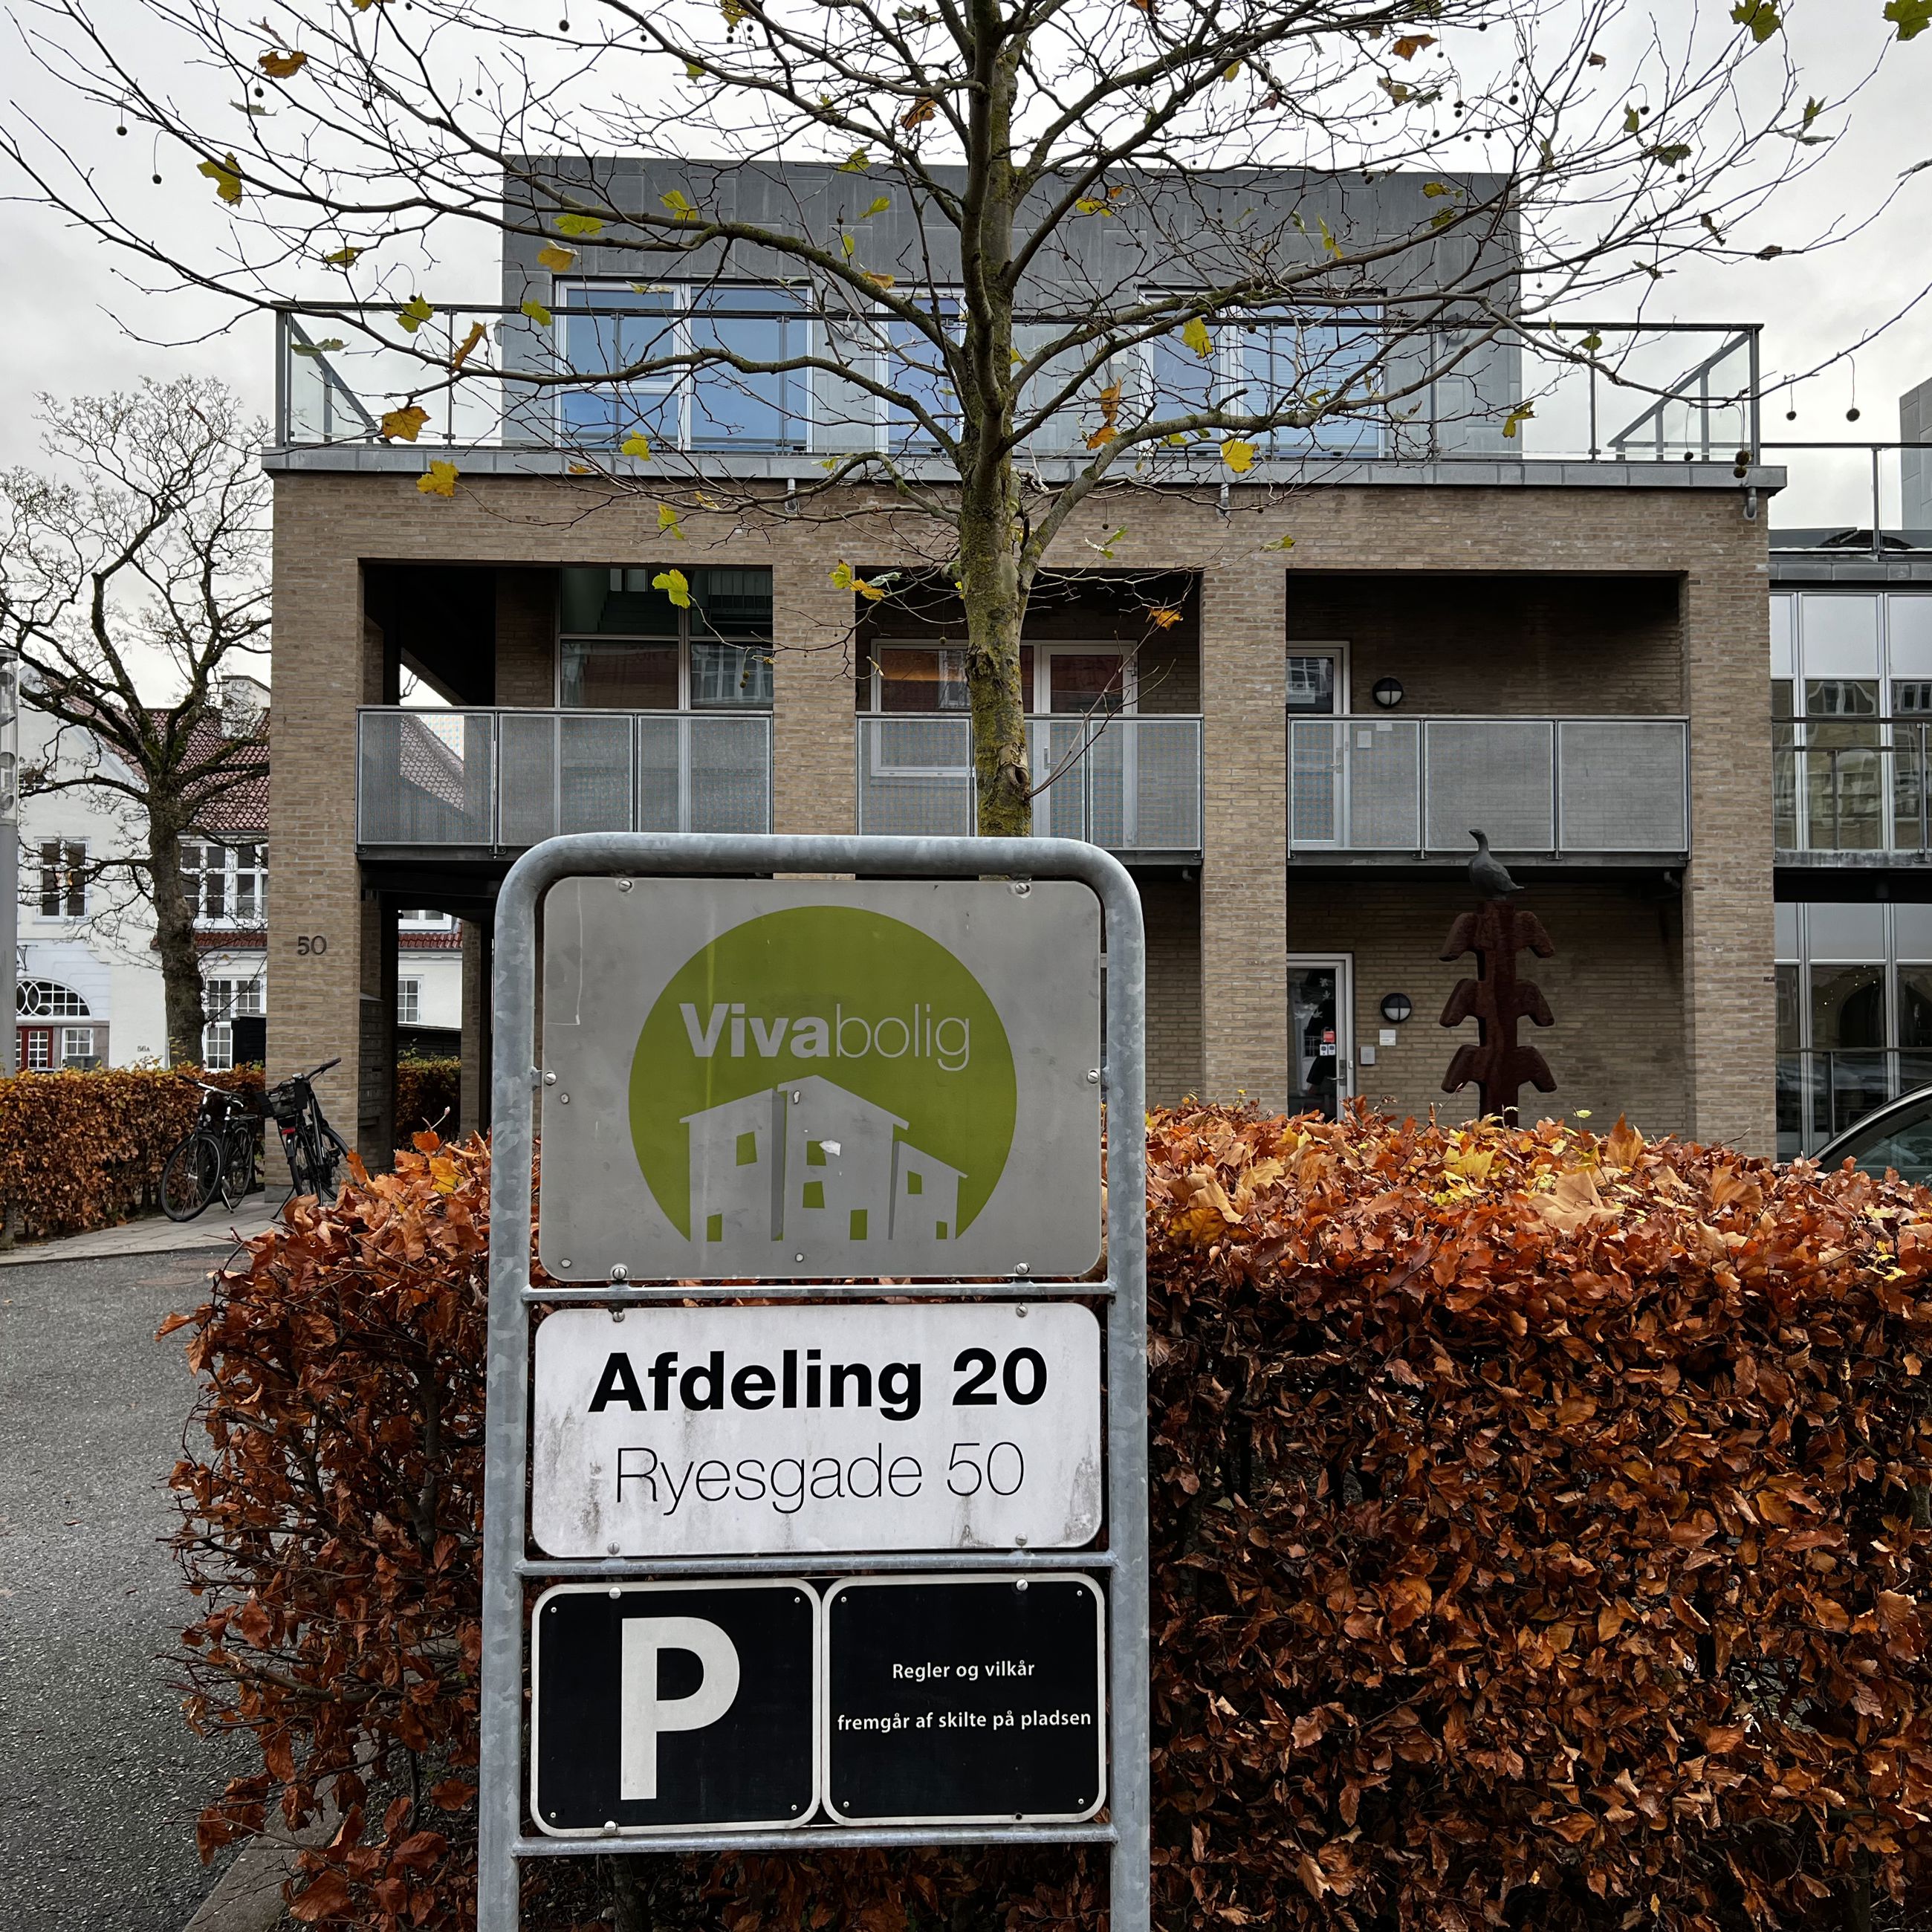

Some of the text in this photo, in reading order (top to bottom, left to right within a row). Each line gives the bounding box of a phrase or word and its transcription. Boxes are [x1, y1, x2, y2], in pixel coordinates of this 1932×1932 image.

[297, 935, 327, 956] 50
[680, 1004, 970, 1072] Vivabolig
[588, 1346, 1048, 1422] Afdeling 20
[617, 1442, 1025, 1517] Ryesgade 50
[892, 1660, 1035, 1682] Regler og vilkår
[621, 1617, 740, 1800] P
[837, 1709, 1091, 1734] fremgår af skilte på pladsen
